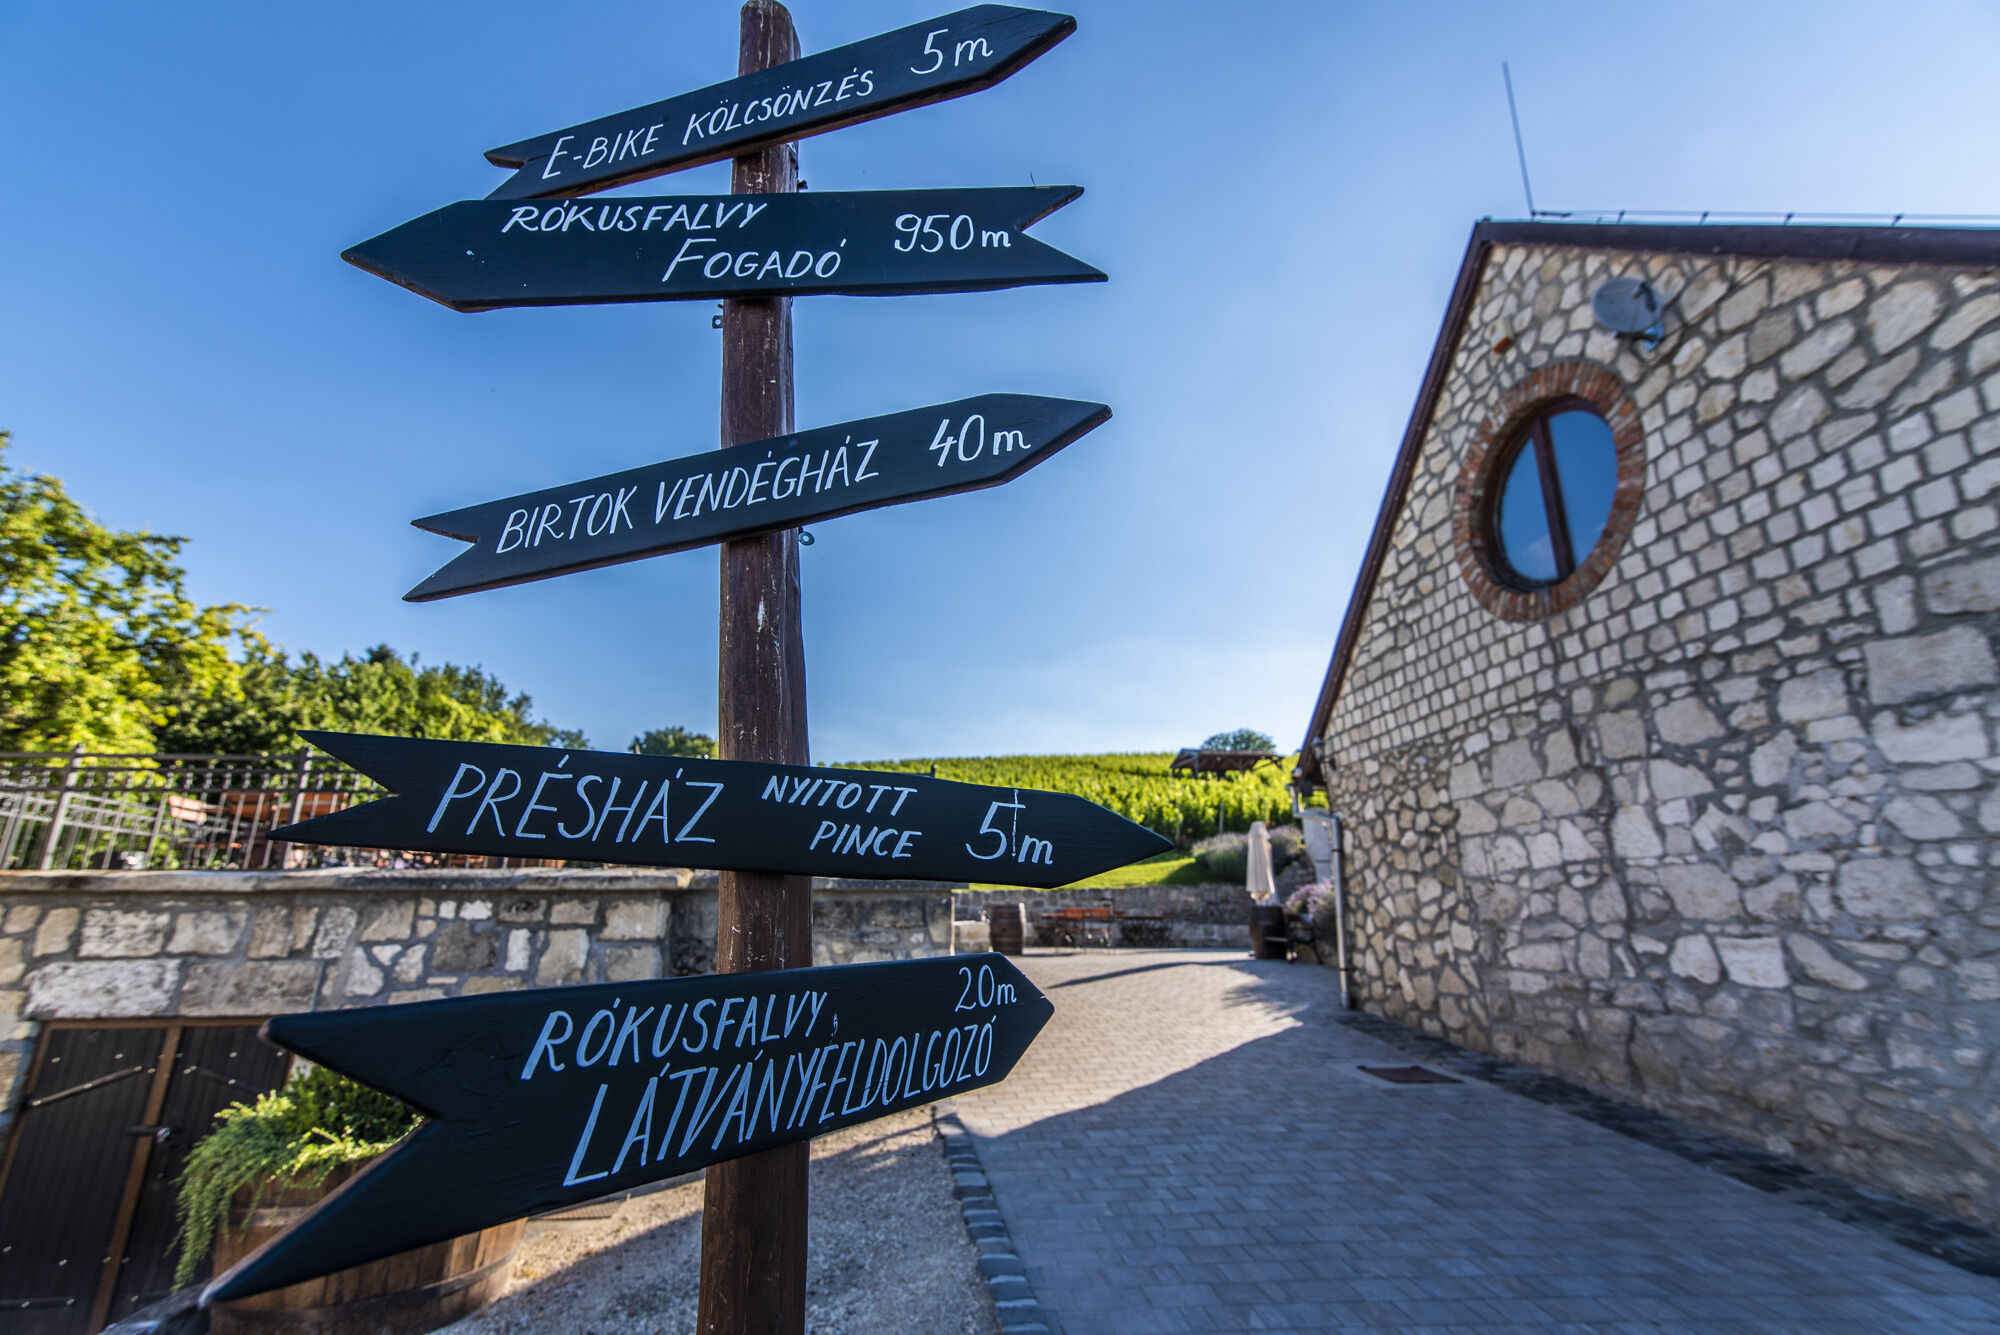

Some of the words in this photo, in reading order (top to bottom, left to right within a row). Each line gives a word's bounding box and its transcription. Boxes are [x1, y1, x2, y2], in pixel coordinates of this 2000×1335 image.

[541, 122, 666, 181] E-BIKE
[682, 67, 874, 146] KÖLCSÖNZÉS
[500, 200, 768, 235] RÓKUSFALVY
[661, 238, 848, 283] FOGADÓ
[495, 485, 639, 555] BIRTOK
[654, 435, 880, 525] VENDÉGHÁZ
[426, 754, 724, 843] PRÉSHÁZ
[761, 774, 918, 816] NYITOTT
[808, 820, 922, 859] PINCE
[520, 990, 828, 1081] RÓKUSFALVY
[562, 1014, 997, 1187] LÁTVÁNYFELDOLGOZÓ
